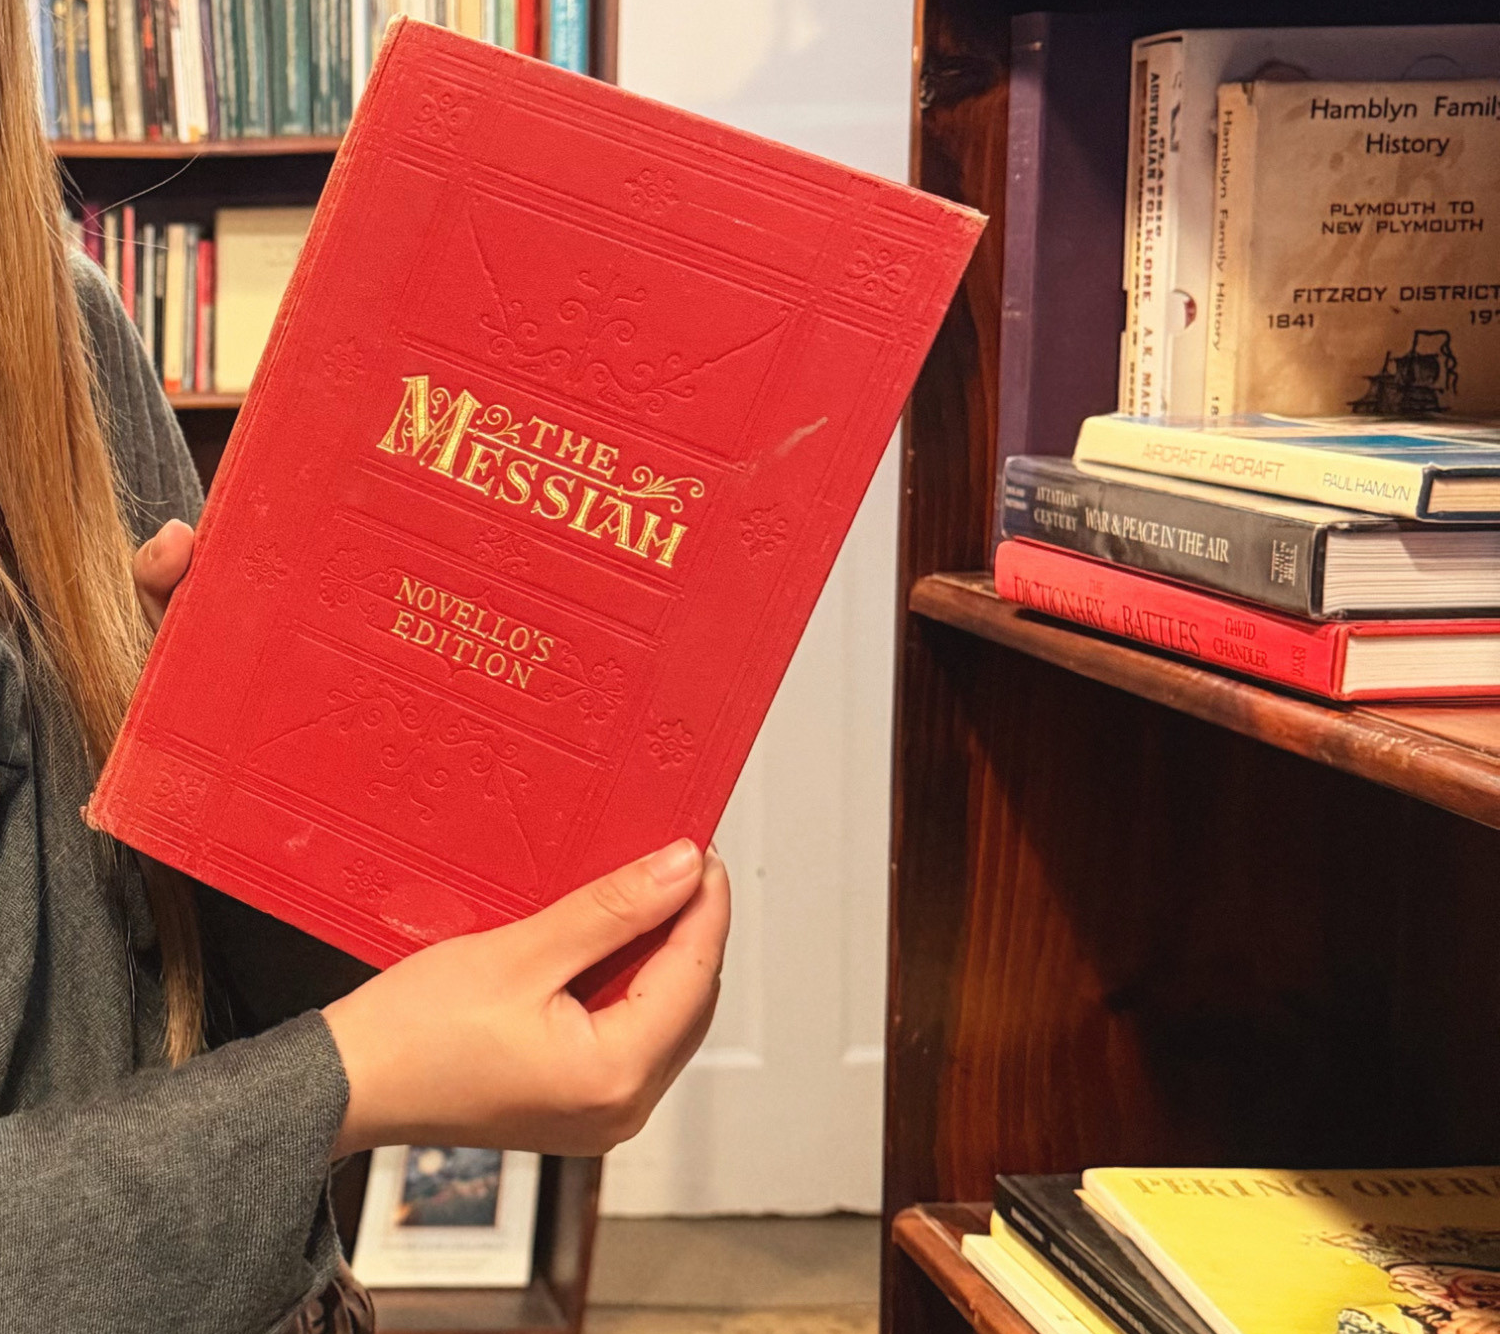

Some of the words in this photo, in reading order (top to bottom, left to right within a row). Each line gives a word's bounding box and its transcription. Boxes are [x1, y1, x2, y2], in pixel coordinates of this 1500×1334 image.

[1145, 71, 1161, 183] AUSTRALIAN
[1310, 96, 1418, 123] Hamblyn
[1217, 110, 1233, 199] Hamblyn
[1365, 132, 1451, 157] History
[1155, 137, 1167, 238] CLASSIC
[1321, 221, 1364, 236] NEW
[1376, 219, 1484, 234] PLYMOUTH
[1330, 201, 1436, 217] PLYMOUTH
[1449, 200, 1475, 215] TO
[1142, 184, 1156, 303] FOLKLORE
[1215, 208, 1229, 273] Family
[1293, 285, 1388, 304] FITZROY
[1399, 284, 1500, 302] DISTRICT
[1212, 282, 1226, 351] History
[1267, 313, 1315, 329] 1841
[527, 415, 621, 480] THE
[1142, 443, 1209, 468] AIRCRAFT
[1210, 453, 1285, 483] AIRCRAFT
[376, 374, 689, 568] MESSIAH
[1322, 471, 1354, 492] PAUL
[1354, 478, 1411, 502] HAMLYN
[1035, 485, 1080, 509] AVIATION
[1033, 508, 1079, 533] CENTURY
[1085, 506, 1109, 533] WAR
[1111, 514, 1122, 536] &
[1122, 516, 1161, 547] PEACE
[1160, 524, 1179, 550] IN
[1178, 528, 1205, 558] THE
[1205, 535, 1231, 564] AIR
[393, 575, 556, 664] NOVELLO'S
[1013, 574, 1106, 629] DICTIONARY
[1121, 604, 1202, 657] BATTLES
[1224, 616, 1257, 641] DAVID
[390, 610, 536, 690] EDITION
[1212, 636, 1269, 669] CHANDLER
[1131, 1176, 1338, 1199] PEKING
[1351, 1177, 1500, 1198] OPER
